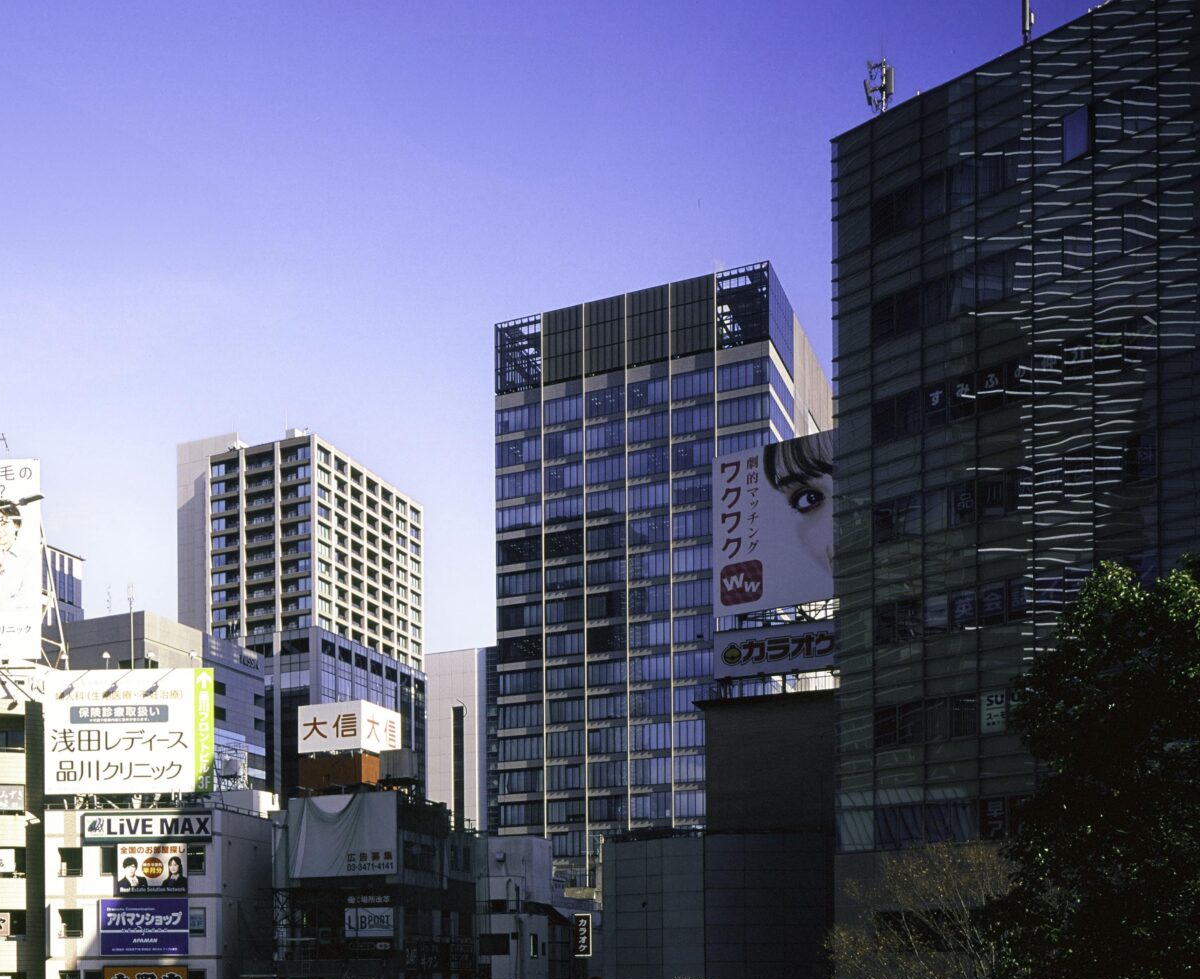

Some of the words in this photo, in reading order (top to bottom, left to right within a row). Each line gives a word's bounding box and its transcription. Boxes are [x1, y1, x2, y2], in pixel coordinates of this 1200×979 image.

[720, 461, 743, 559] ワクワク
[746, 456, 760, 555] 劇的マッチング
[78, 706, 160, 718] 保険診療取扱い
[302, 713, 357, 741] 大信
[366, 712, 397, 748] 大信
[52, 728, 188, 752] 浅田レディース
[56, 760, 183, 782] 品川クリニック
[198, 776, 210, 789] 3F
[106, 818, 153, 835] LiVE
[160, 817, 210, 835] MAX
[120, 845, 186, 854] 全国のお部屋探し
[347, 852, 393, 862] 広告募集
[347, 862, 393, 872] 03-3471-4141
[106, 911, 183, 926] アパマンショップ
[578, 918, 588, 952] カラオケ
